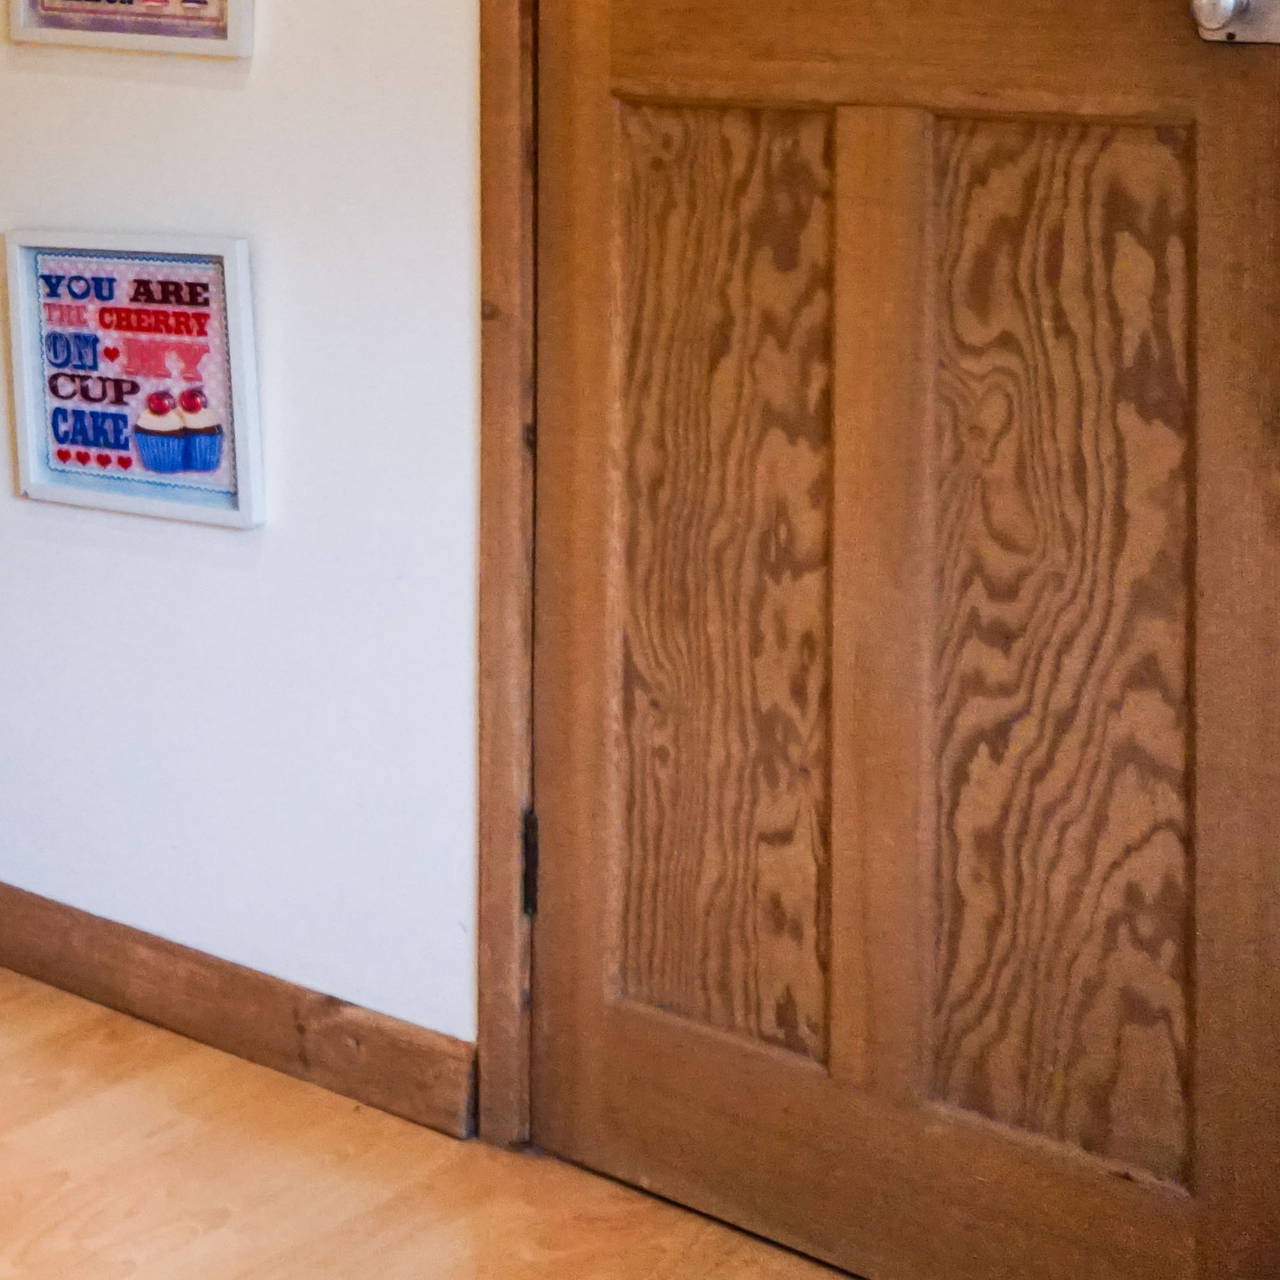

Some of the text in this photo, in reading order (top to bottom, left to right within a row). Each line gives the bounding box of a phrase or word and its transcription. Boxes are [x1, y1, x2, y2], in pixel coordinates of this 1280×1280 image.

[39, 274, 210, 307] YOU ARE
[43, 302, 211, 337] THE CHERRY
[44, 331, 100, 371] ON
[48, 372, 141, 406] CUP
[50, 406, 131, 451] CAKE
